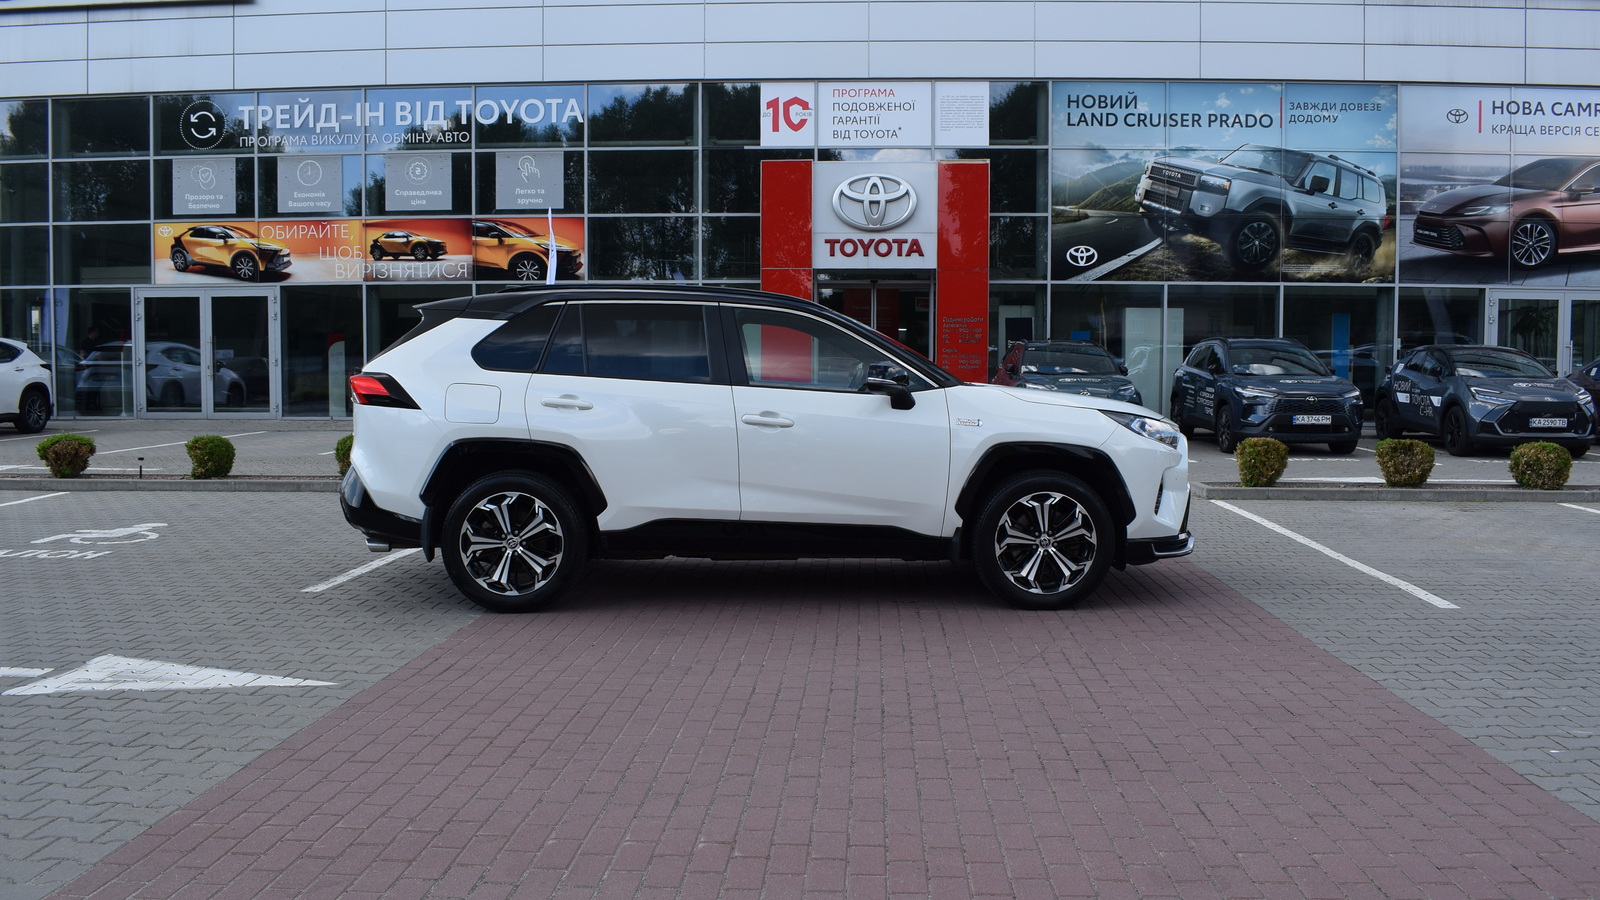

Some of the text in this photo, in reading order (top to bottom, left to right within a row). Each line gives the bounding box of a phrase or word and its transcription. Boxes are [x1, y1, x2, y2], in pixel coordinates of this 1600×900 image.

[832, 88, 896, 98] ПРОГРАМА
[1067, 91, 1138, 109] НОВИЙ
[832, 100, 917, 113] ПОДОВЖЕНОЇ
[1289, 102, 1383, 113] ЗАВЖДИ ДОВЕЗЕ
[1492, 100, 1546, 116] НОВА
[238, 97, 584, 133] ТРЕЙД-ІН ВІД TOYOTA
[766, 96, 809, 132] 10
[1288, 114, 1339, 125] ДОДОМУ
[832, 114, 881, 126] ГАРАНТІЇ
[1067, 112, 1274, 128] LAND CRUISER PRADO
[832, 130, 851, 141] ВІД
[1491, 124, 1537, 137] КРАЩА
[1540, 125, 1581, 136] ВЕРСІЯ
[239, 131, 470, 147] ПРОГРАМА ВИКУПУ ТА ОБМІНУ АВТО
[1162, 169, 1181, 179] TOYOTA
[293, 191, 326, 199] Економія
[394, 189, 442, 198] Справедлива
[515, 187, 536, 195] Легко
[184, 193, 215, 202] Прозоро
[410, 198, 426, 206] ціна
[517, 197, 543, 205] зручно
[188, 201, 221, 209] безпечно
[288, 200, 332, 208] Вашого часу
[261, 222, 354, 241] ОБИРАЙТЕ,
[824, 238, 925, 257] TOYOTA
[319, 246, 363, 262] ЩОБ
[335, 262, 468, 279] ВИРІЗНЯТИСЯ
[1393, 380, 1411, 391] НОВИЙ
[1197, 397, 1214, 407] CROSS
[1411, 394, 1430, 405] TOYOTA
[1420, 406, 1434, 417] C-HR
